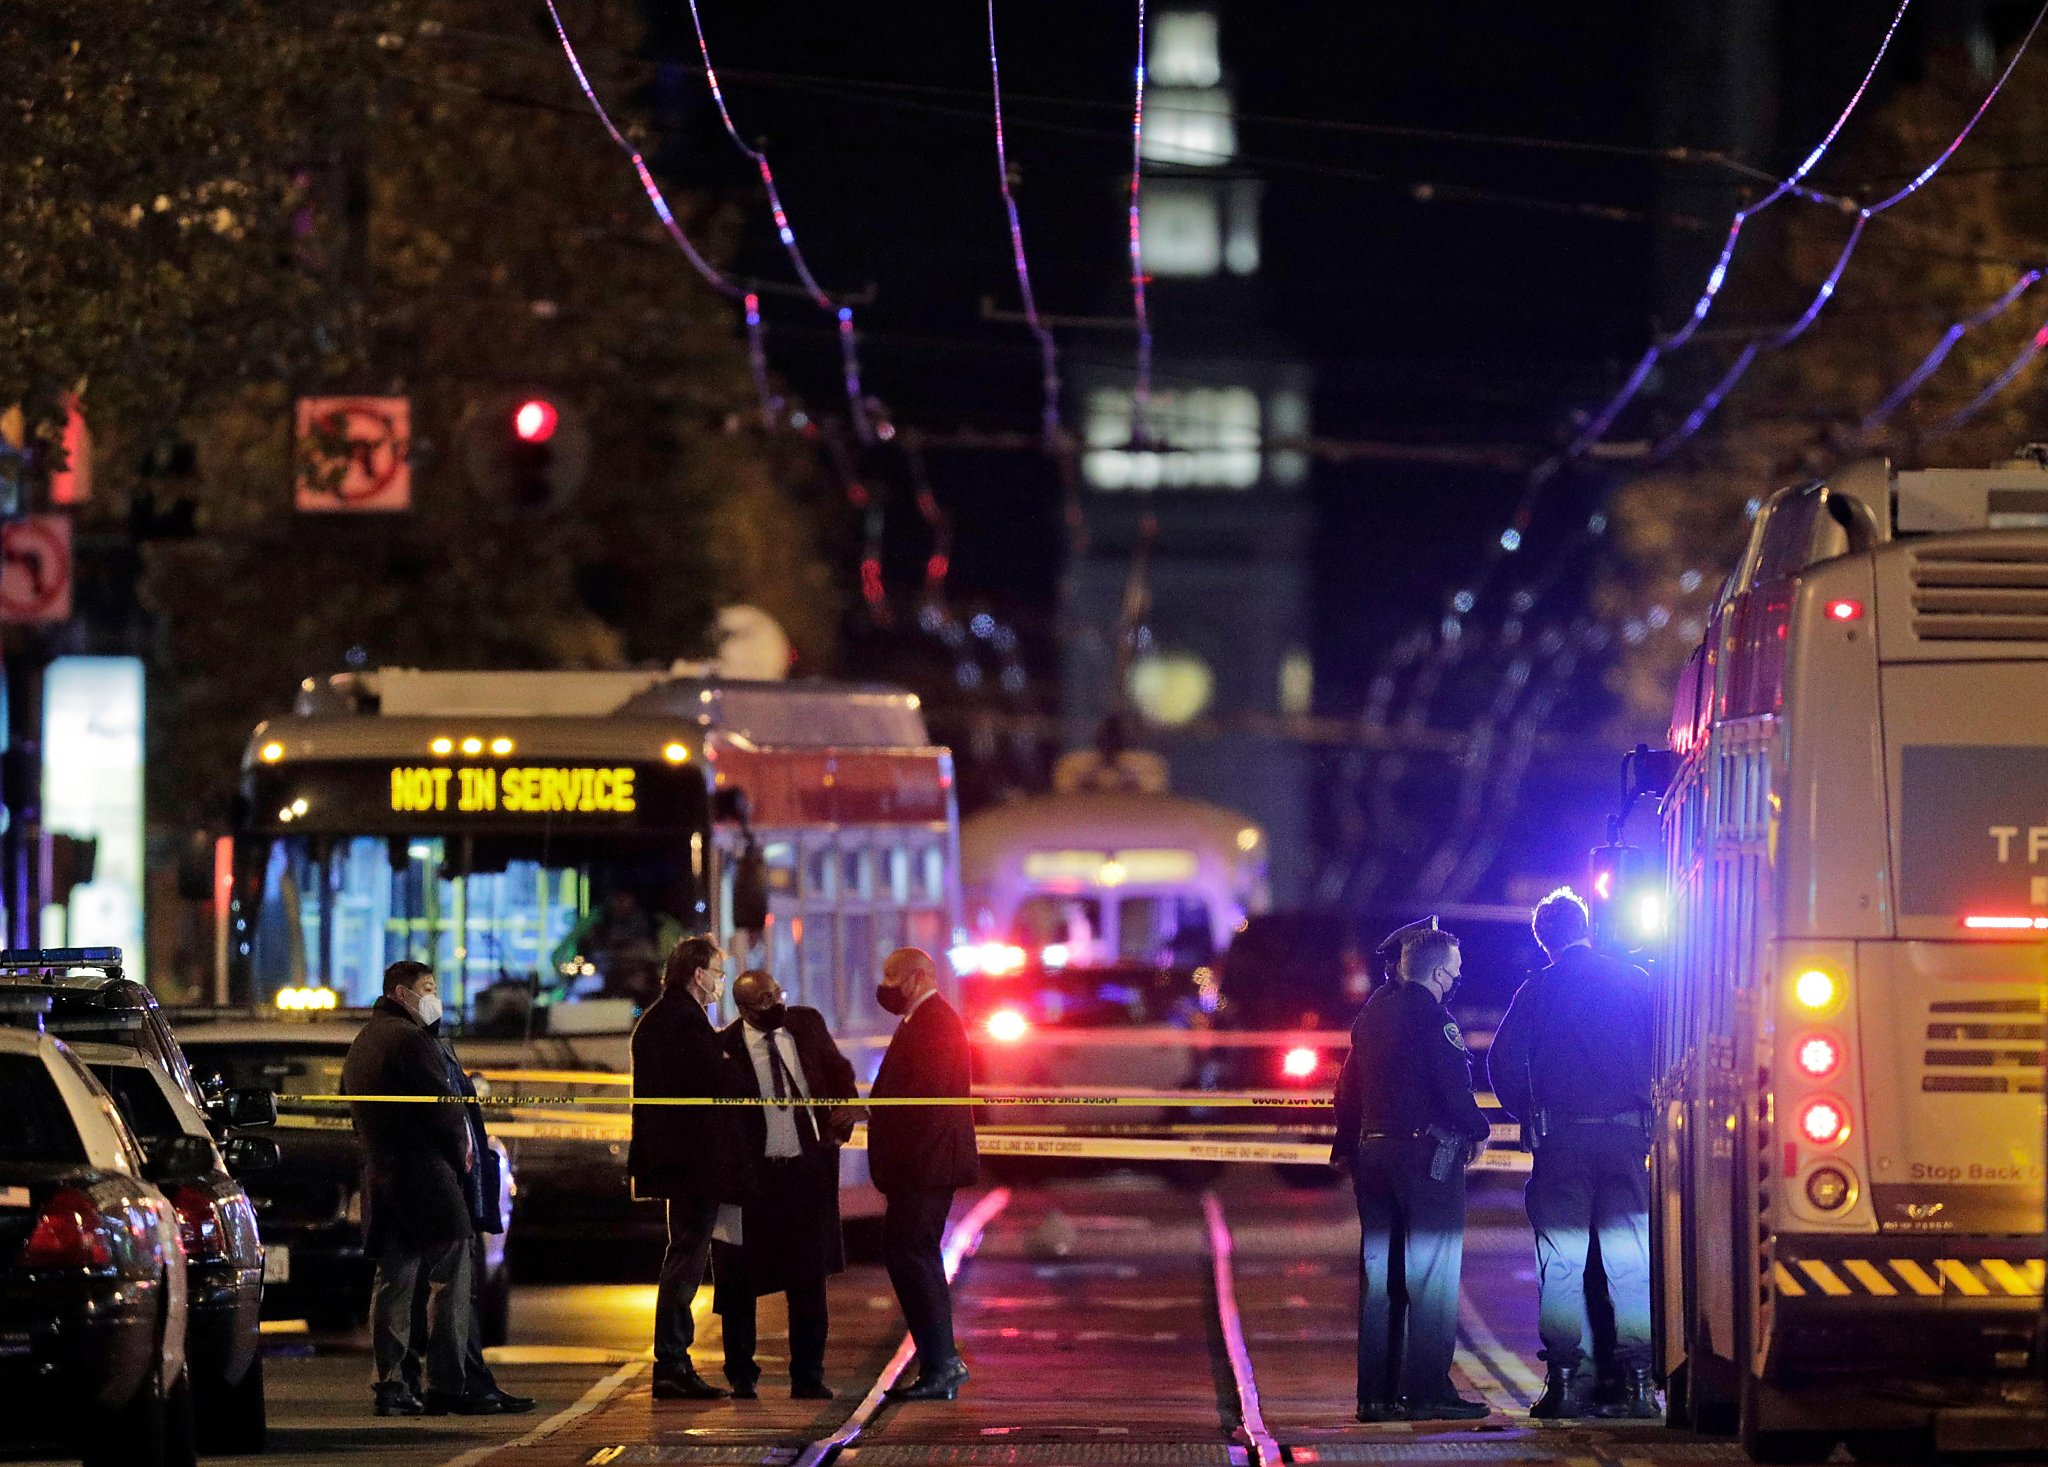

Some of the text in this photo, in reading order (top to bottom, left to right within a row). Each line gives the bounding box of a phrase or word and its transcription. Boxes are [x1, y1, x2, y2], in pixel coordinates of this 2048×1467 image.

[391, 767, 636, 812] NOT IN SERVICE
[1911, 1162, 1961, 1181] Stop
[1969, 1162, 2020, 1180] Back
